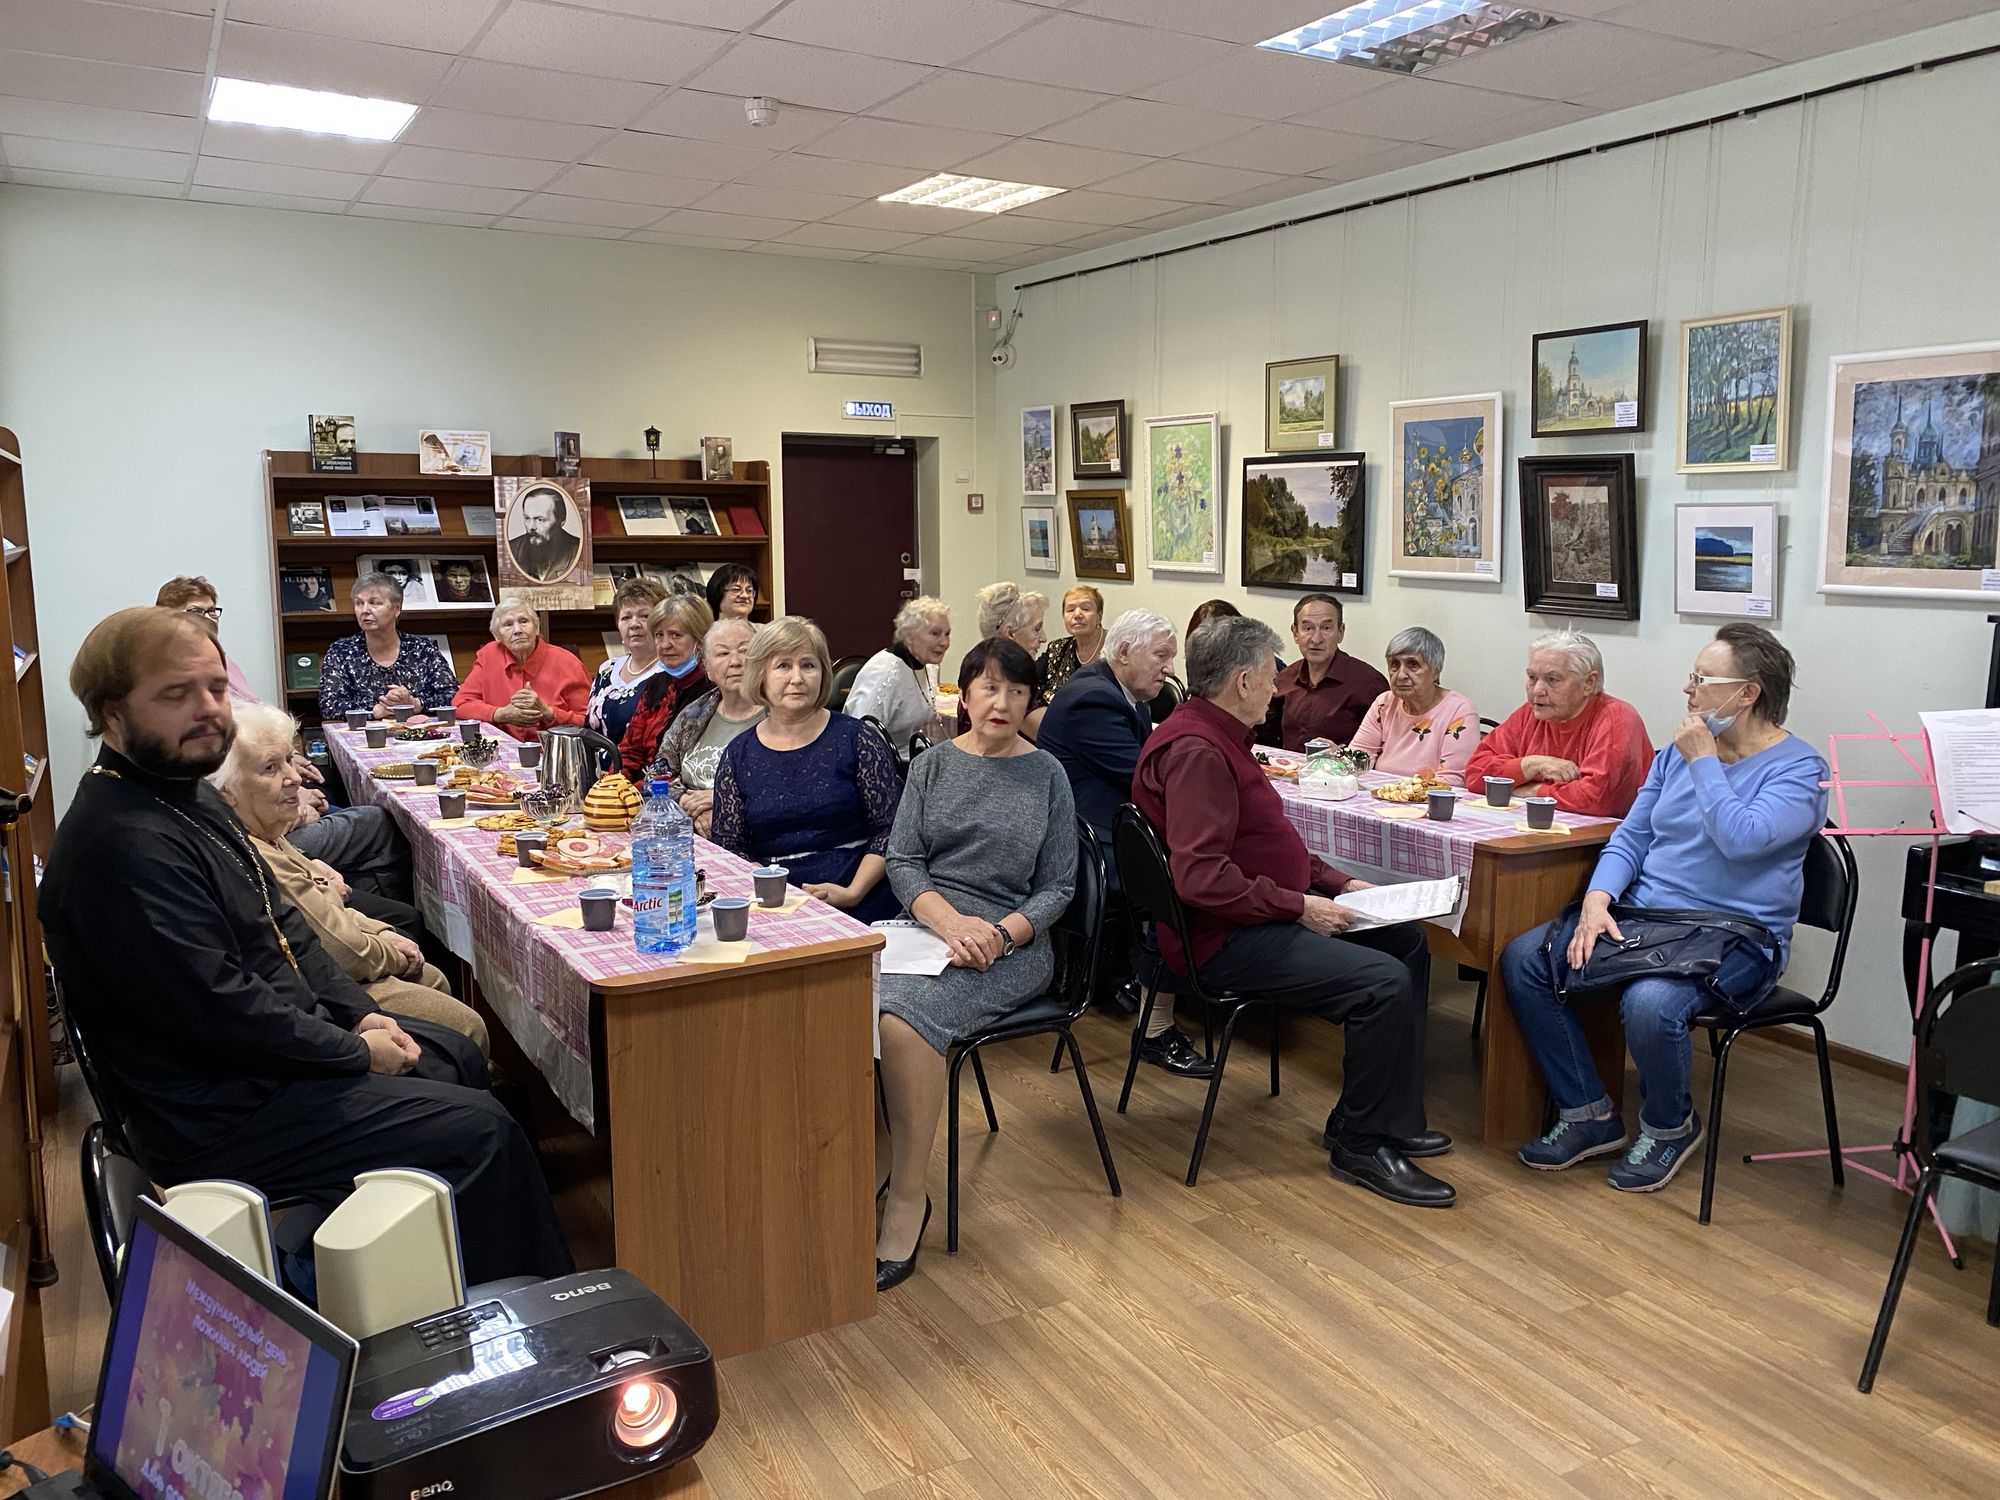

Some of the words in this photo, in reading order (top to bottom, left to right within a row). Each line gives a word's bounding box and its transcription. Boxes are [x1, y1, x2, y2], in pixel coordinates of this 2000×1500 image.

[846, 402, 891, 418] ВЫХОД
[634, 897, 663, 912] Arctic
[550, 1282, 612, 1302] BenQ
[410, 1480, 455, 1500] BenQ
